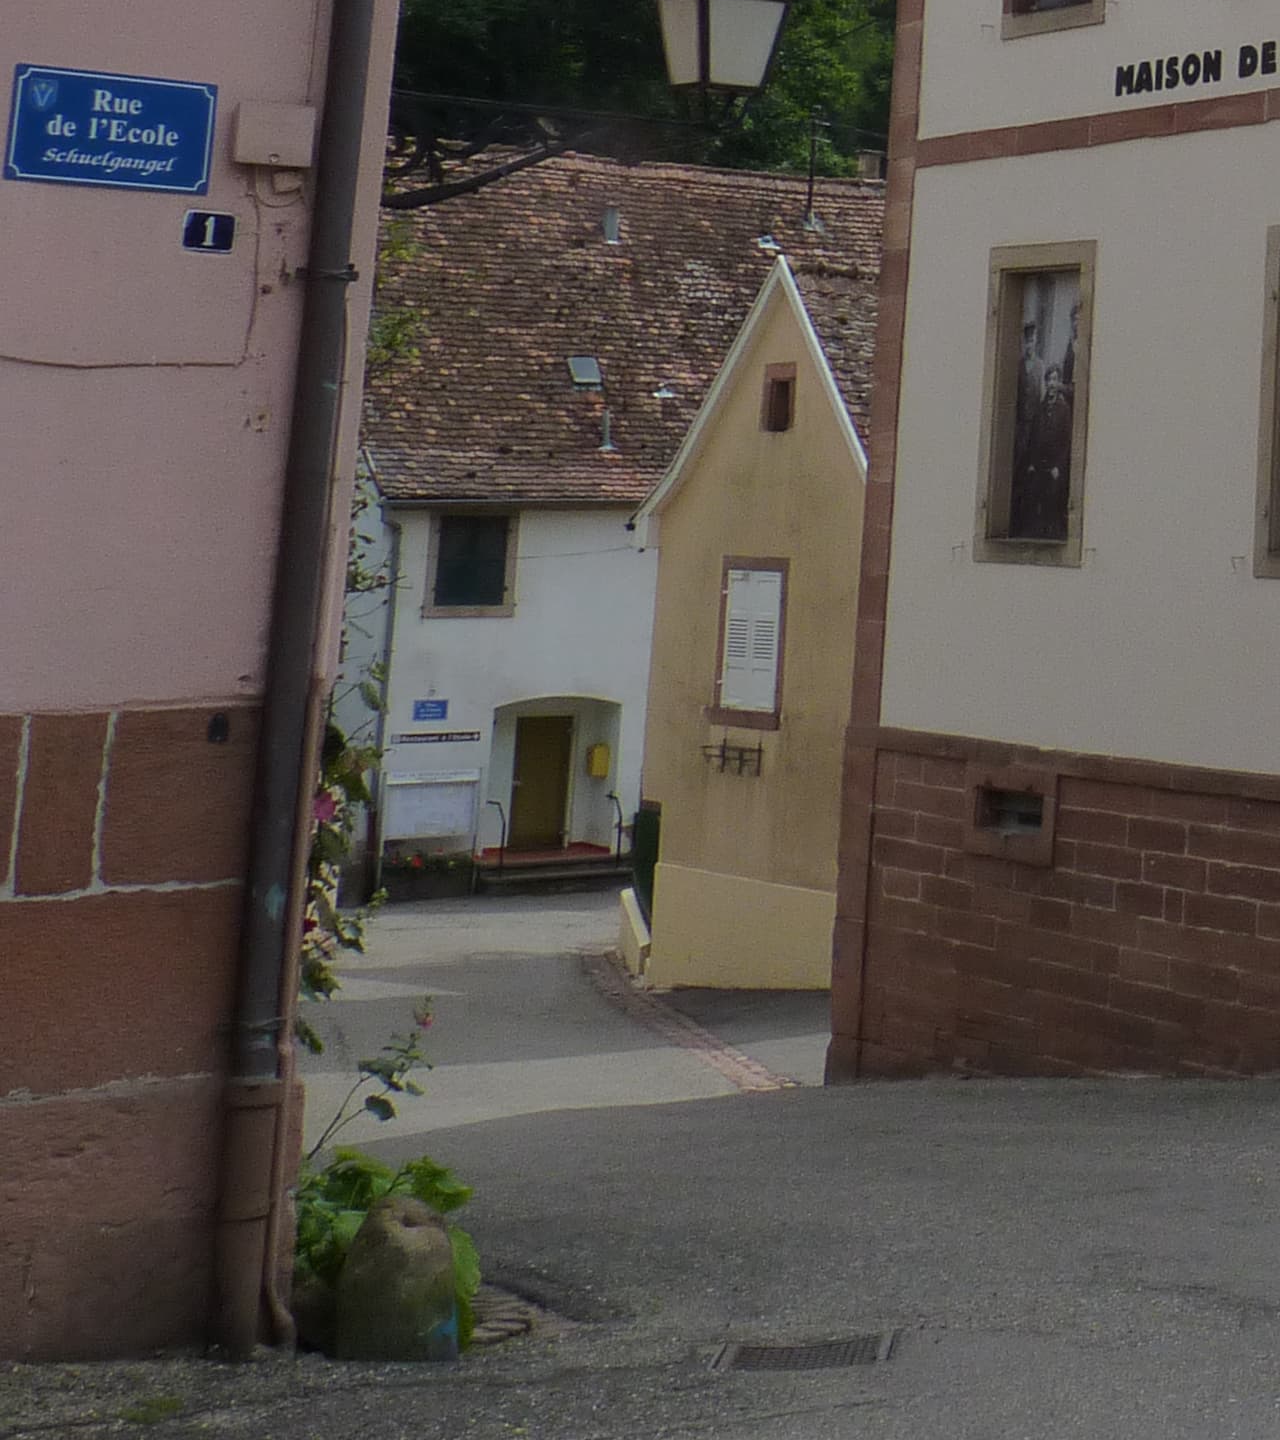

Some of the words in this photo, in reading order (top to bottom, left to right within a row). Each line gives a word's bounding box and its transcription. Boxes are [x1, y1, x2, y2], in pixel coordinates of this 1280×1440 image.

[1115, 49, 1222, 96] MAISON
[1238, 41, 1277, 78] DE
[93, 88, 143, 115] Rue
[46, 114, 77, 137] de
[89, 117, 179, 147] l'Ecole
[202, 216, 215, 247] 1
